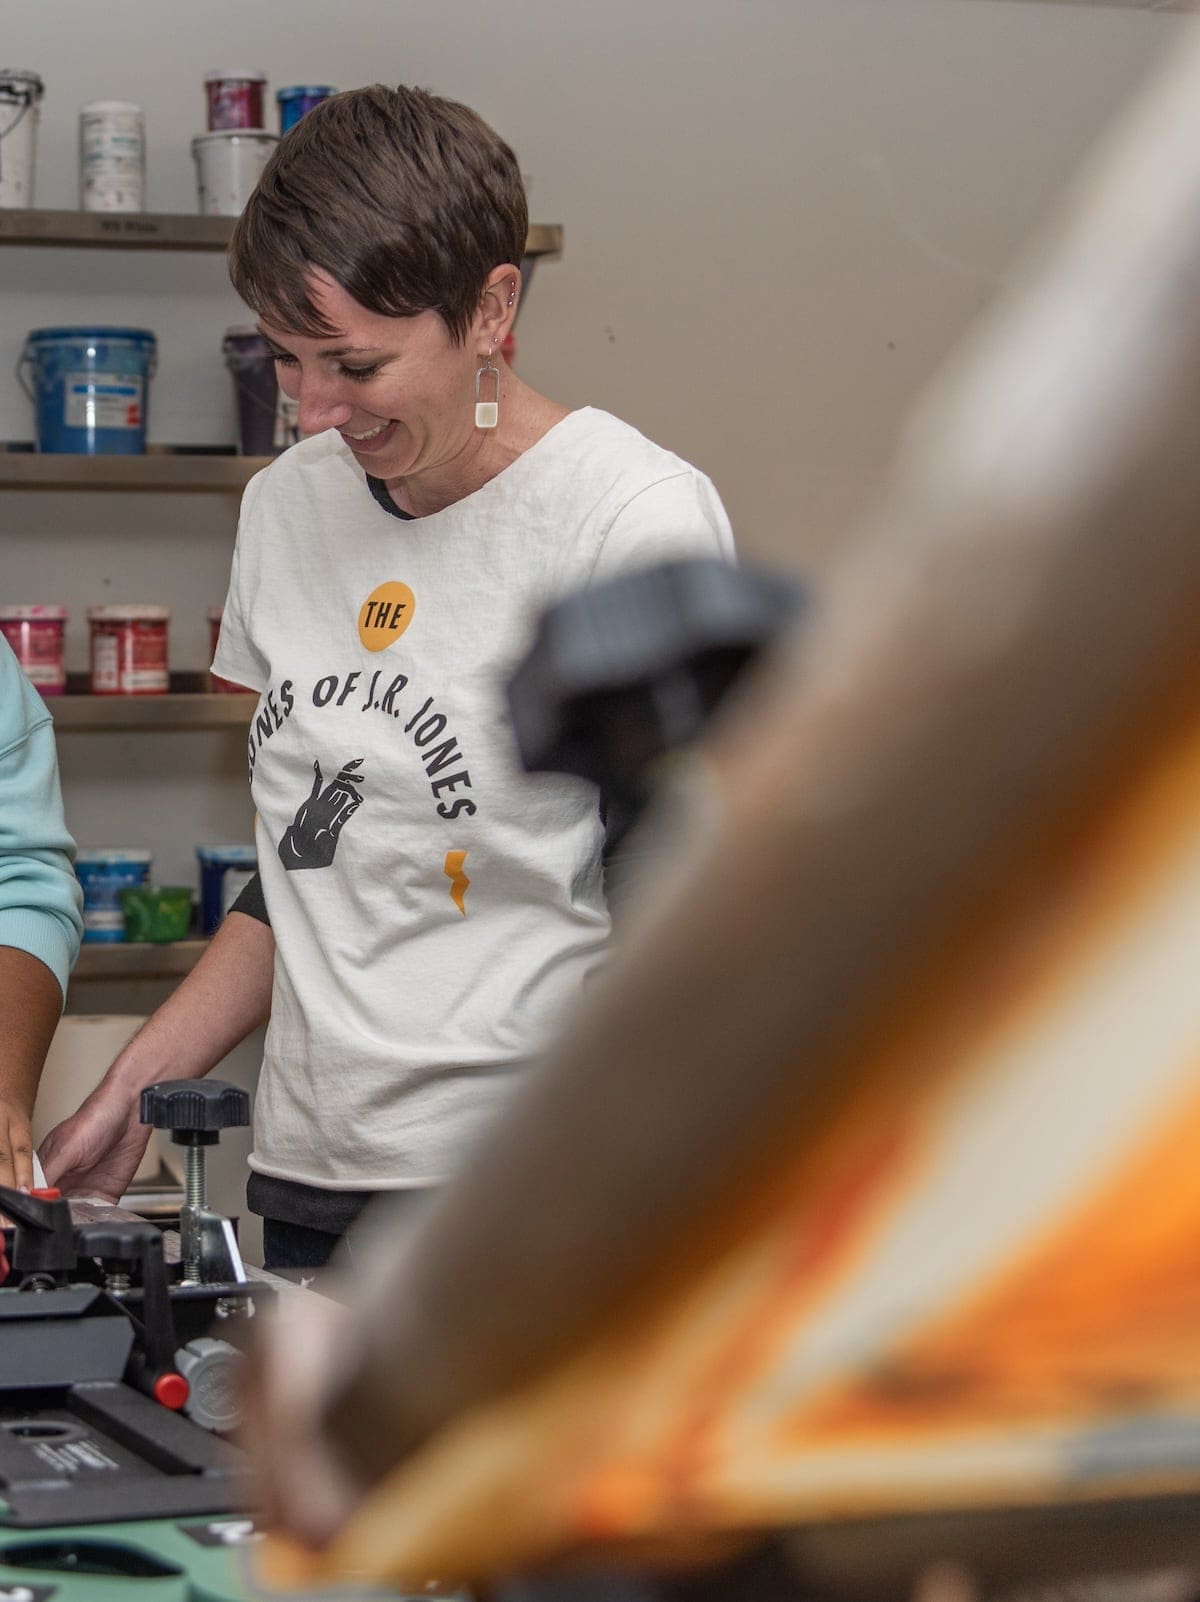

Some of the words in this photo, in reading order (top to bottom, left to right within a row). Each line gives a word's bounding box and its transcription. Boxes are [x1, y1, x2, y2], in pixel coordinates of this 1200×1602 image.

[364, 601, 407, 630] THE
[312, 671, 362, 708] OF
[362, 670, 409, 718] J.R.
[404, 696, 478, 820] JONES
